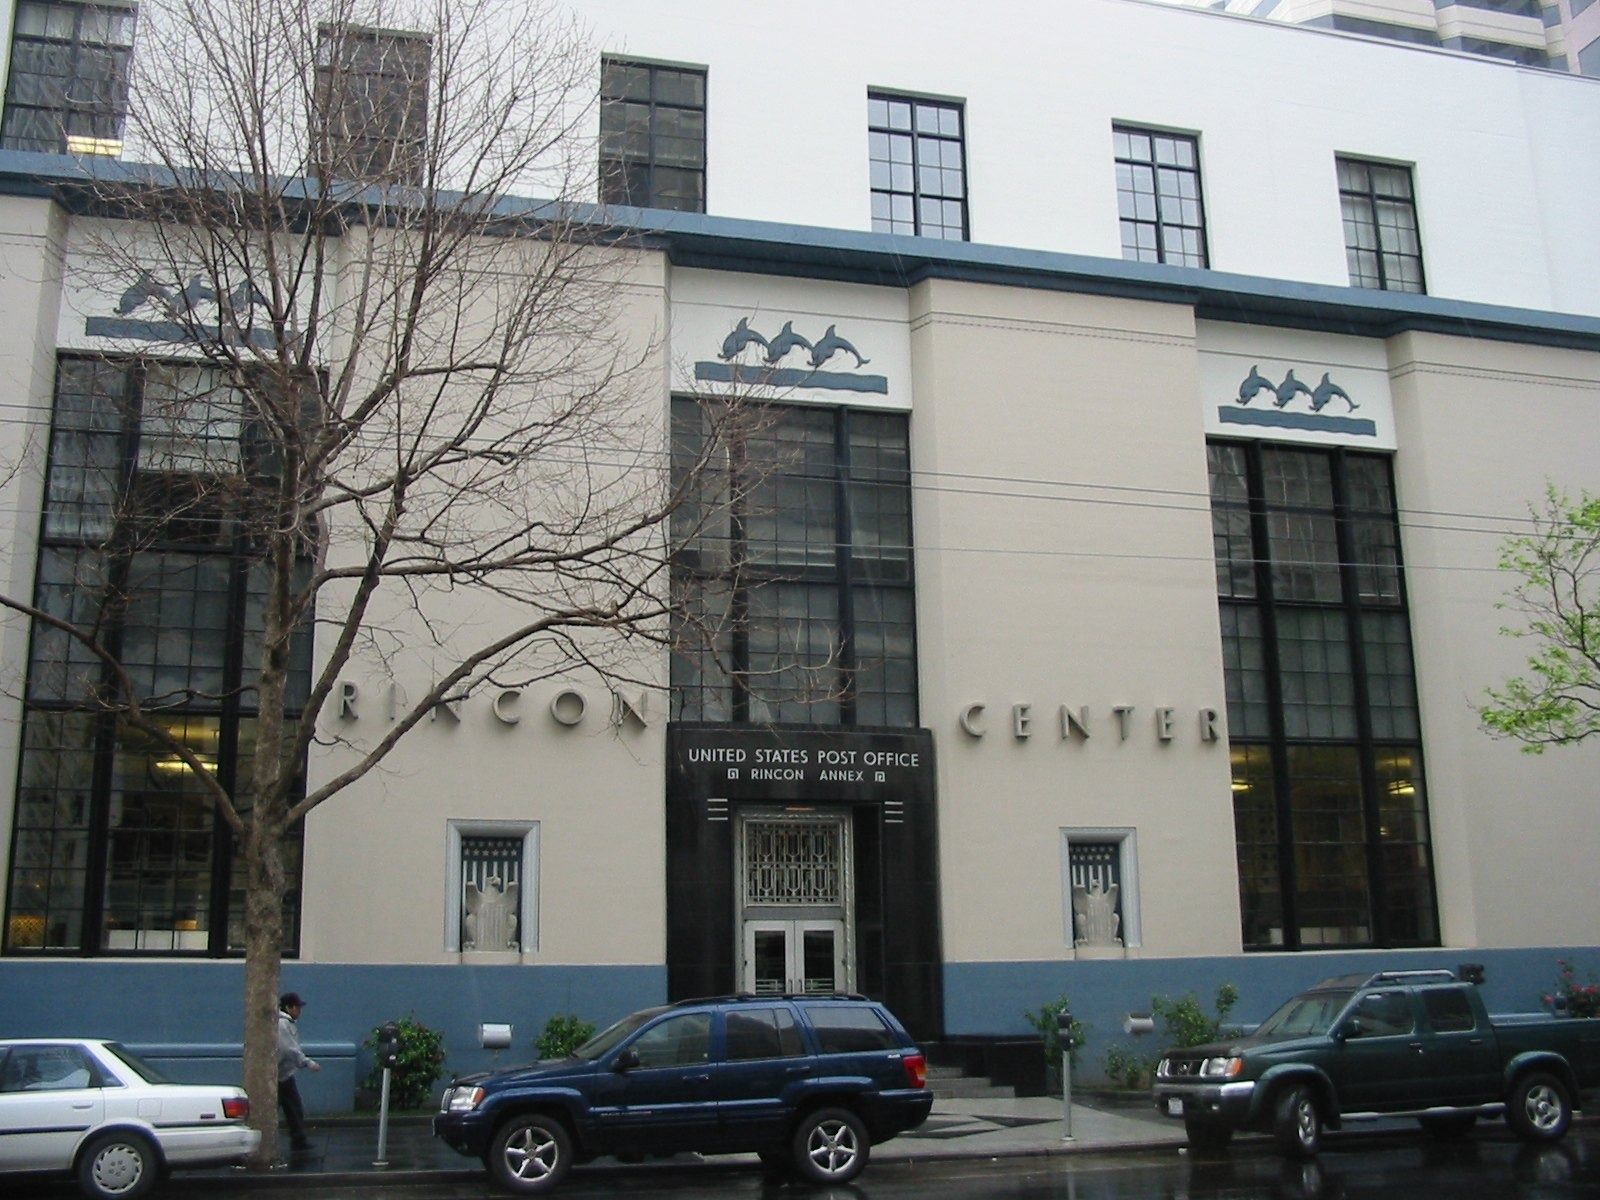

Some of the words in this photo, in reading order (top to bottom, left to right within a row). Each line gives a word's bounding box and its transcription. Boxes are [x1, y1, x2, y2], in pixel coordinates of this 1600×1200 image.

[959, 701, 1221, 743] CENTER
[688, 748, 746, 763] UNITED
[755, 749, 809, 764] STATES
[817, 750, 857, 765] POST
[863, 751, 919, 767] OFFICE
[751, 768, 804, 780] RINCON
[819, 769, 864, 782] ANNEX
